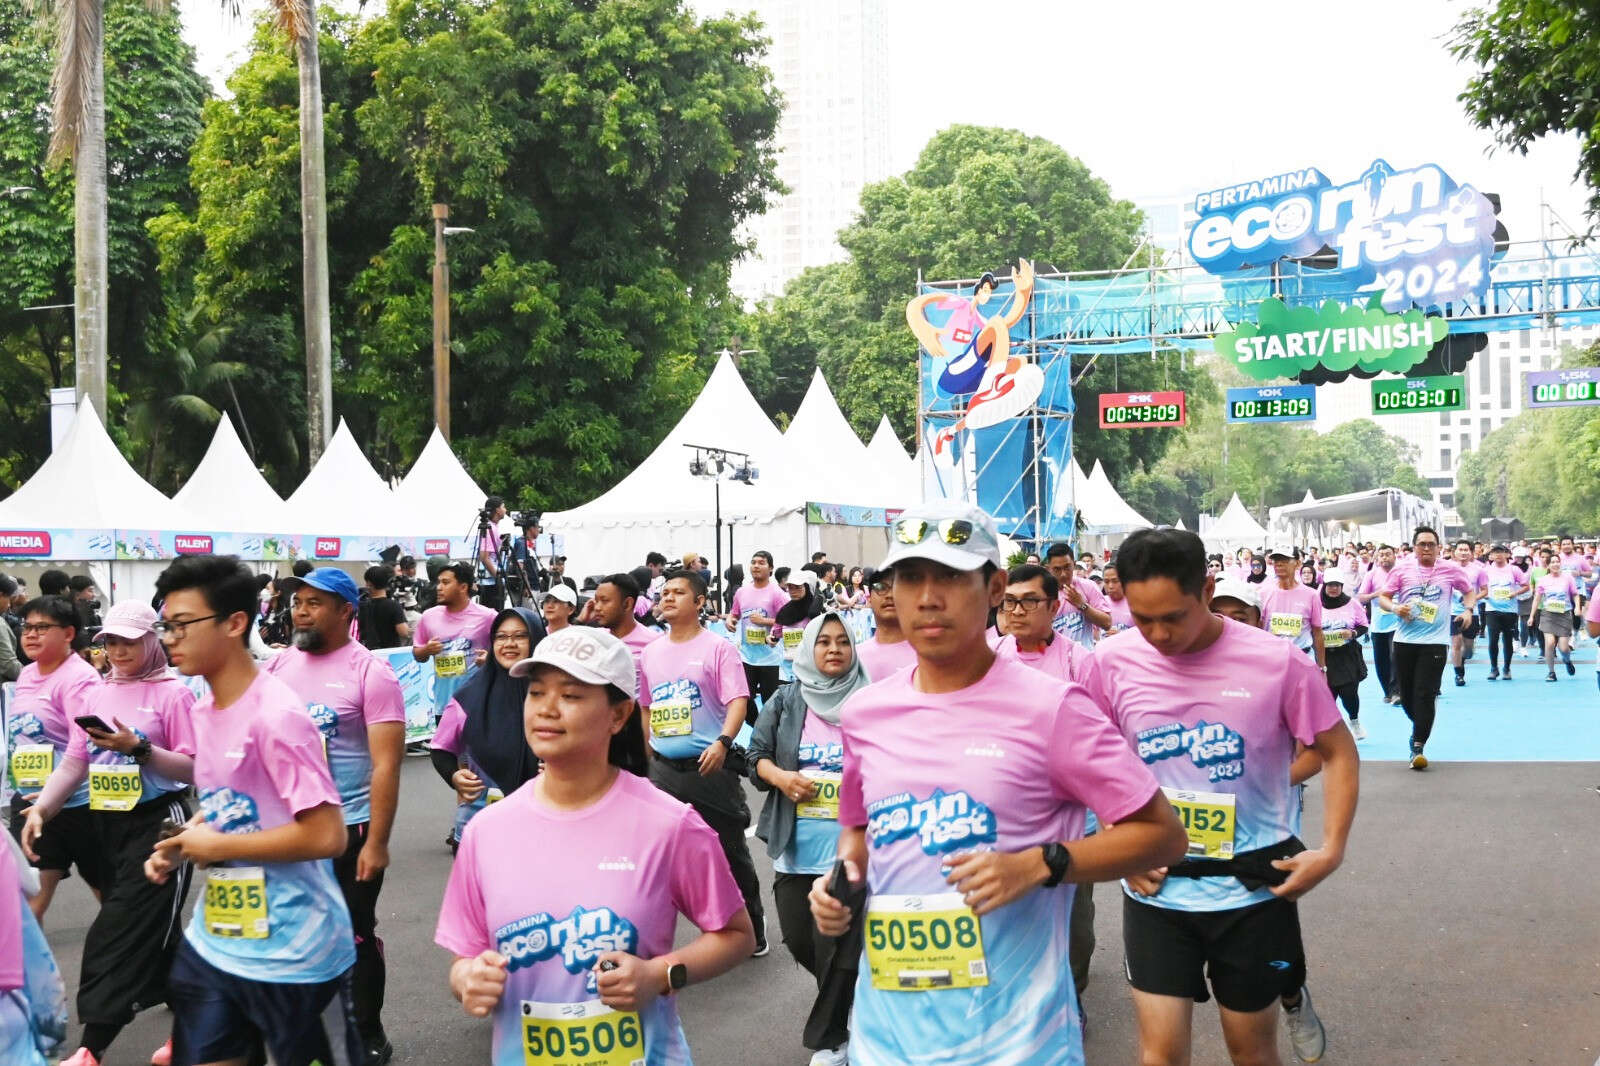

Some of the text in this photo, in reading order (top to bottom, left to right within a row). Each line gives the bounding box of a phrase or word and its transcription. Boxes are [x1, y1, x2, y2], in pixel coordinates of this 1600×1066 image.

[1196, 167, 1320, 212] PERTAMINA
[1191, 197, 1313, 259] eco
[1336, 187, 1479, 269] fest
[1381, 253, 1484, 305] 2024
[1235, 320, 1434, 363] START/FINISH
[1256, 388, 1284, 397] 10K
[1406, 379, 1427, 389] 5K
[1127, 393, 1153, 403] 21K
[1235, 399, 1309, 418] 00:13:09
[1378, 389, 1457, 410] 00:03:01
[1106, 405, 1177, 423] 00:43:09
[0, 536, 44, 549] MEDIA
[175, 539, 211, 550] TALENT
[425, 542, 449, 551] TALENT
[651, 706, 690, 723] 53059
[1138, 735, 1180, 759] eco
[1189, 735, 1240, 762] fest
[1208, 762, 1242, 780] 2024
[92, 774, 141, 793] 50690
[919, 807, 988, 847] fest
[869, 915, 977, 952] 50508
[562, 924, 631, 967] fest
[527, 1016, 639, 1058] 50506
